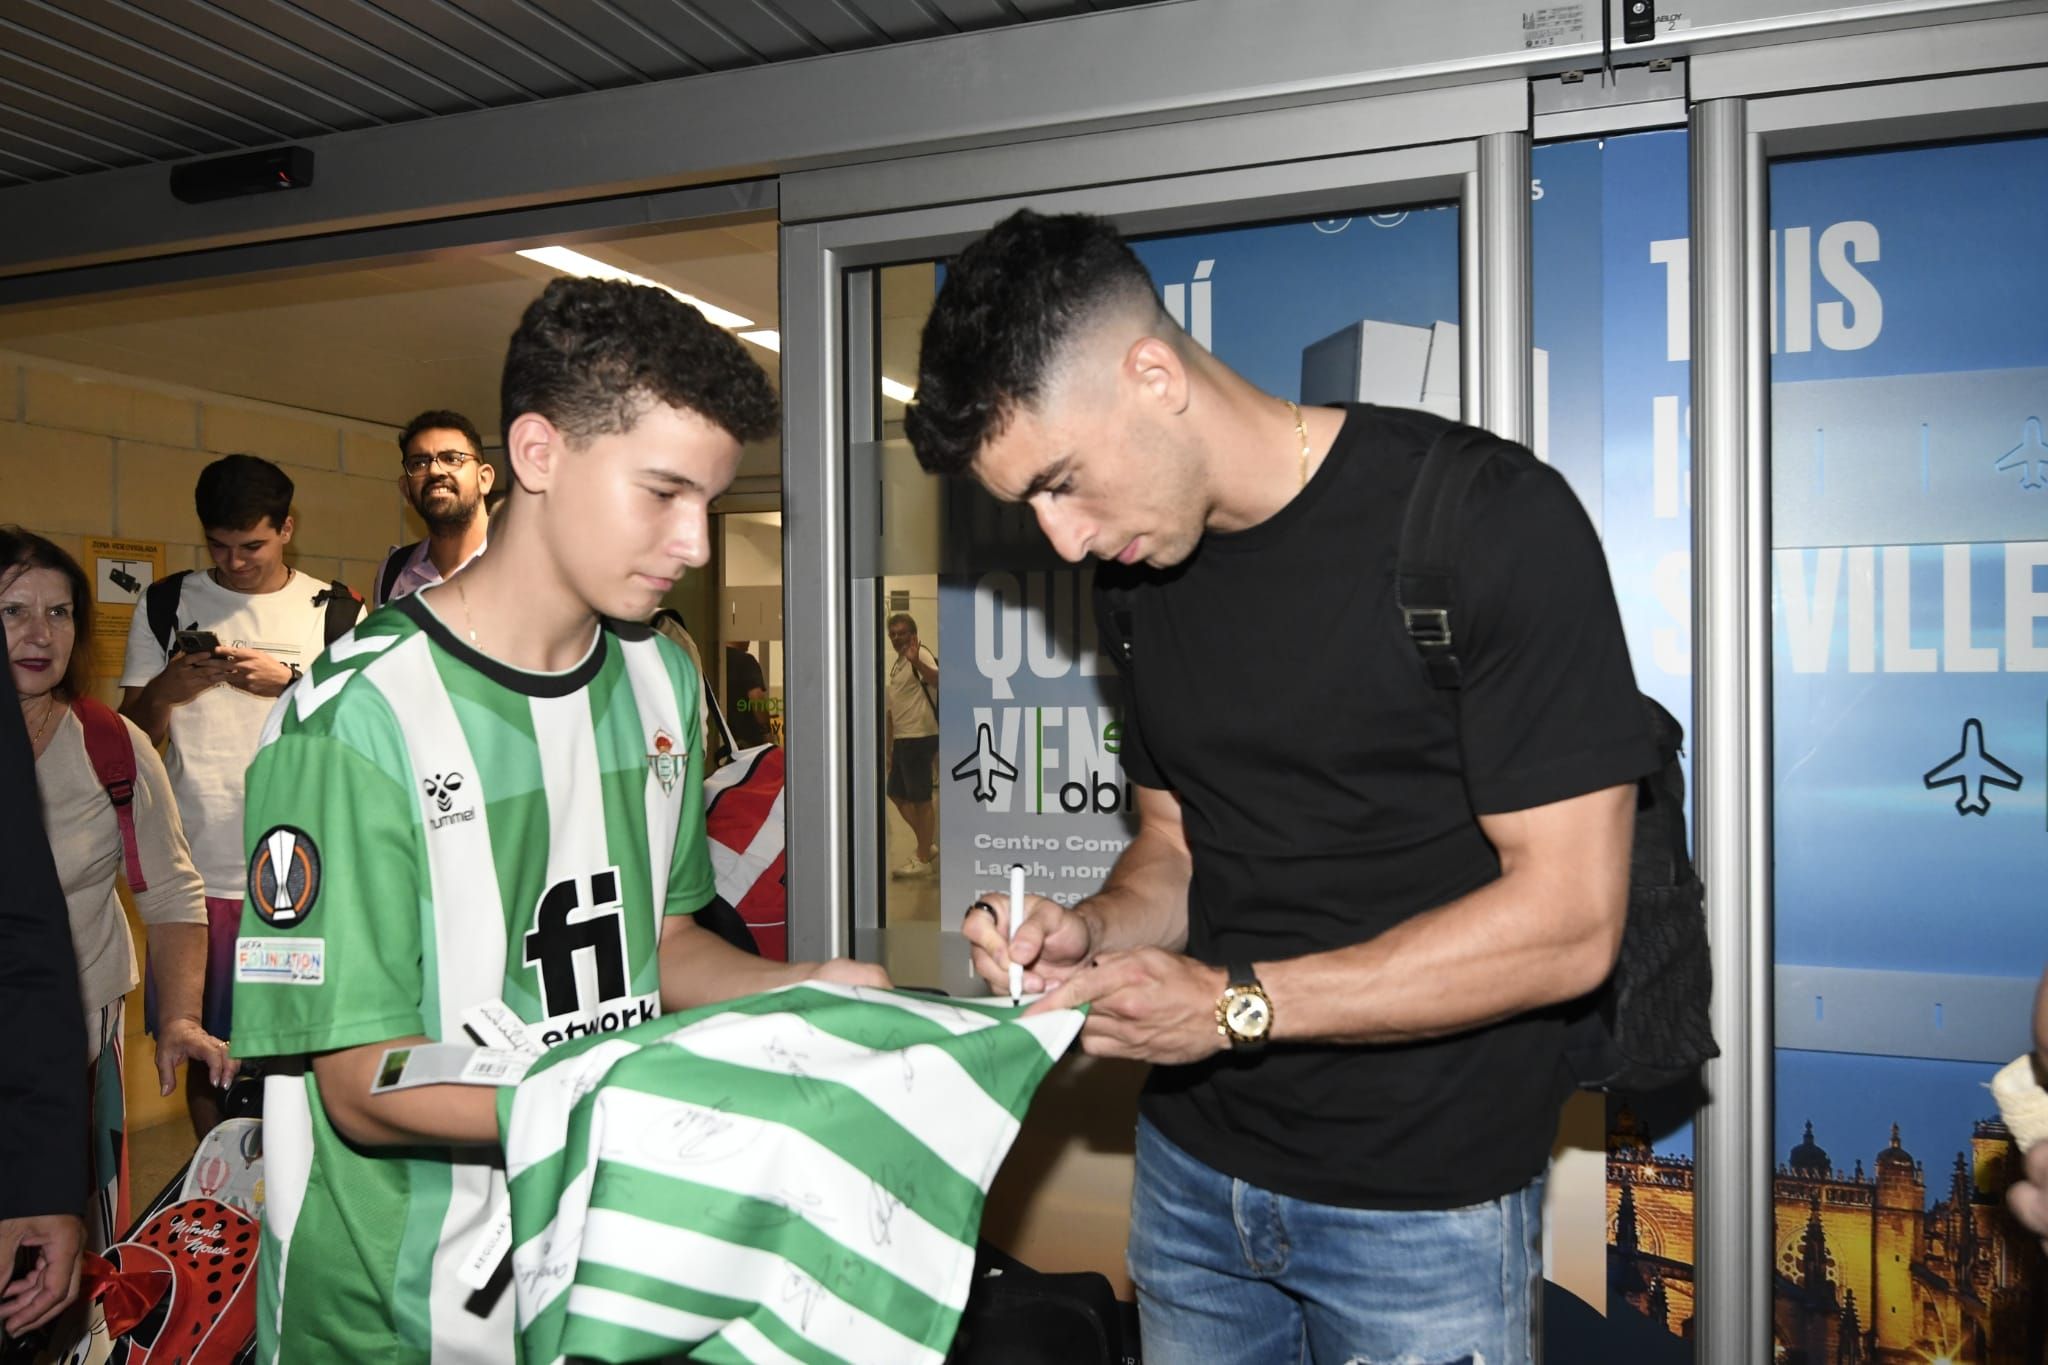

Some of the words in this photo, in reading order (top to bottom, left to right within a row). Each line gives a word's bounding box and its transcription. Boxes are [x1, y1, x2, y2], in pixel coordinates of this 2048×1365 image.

[1650, 221, 1884, 361] TIS
[1652, 542, 2048, 676] SVILLE
[973, 706, 1125, 814] VEN
[974, 834, 1060, 850] Centro
[169, 1215, 223, 1239] Minnie
[183, 1235, 231, 1259] Mouse
